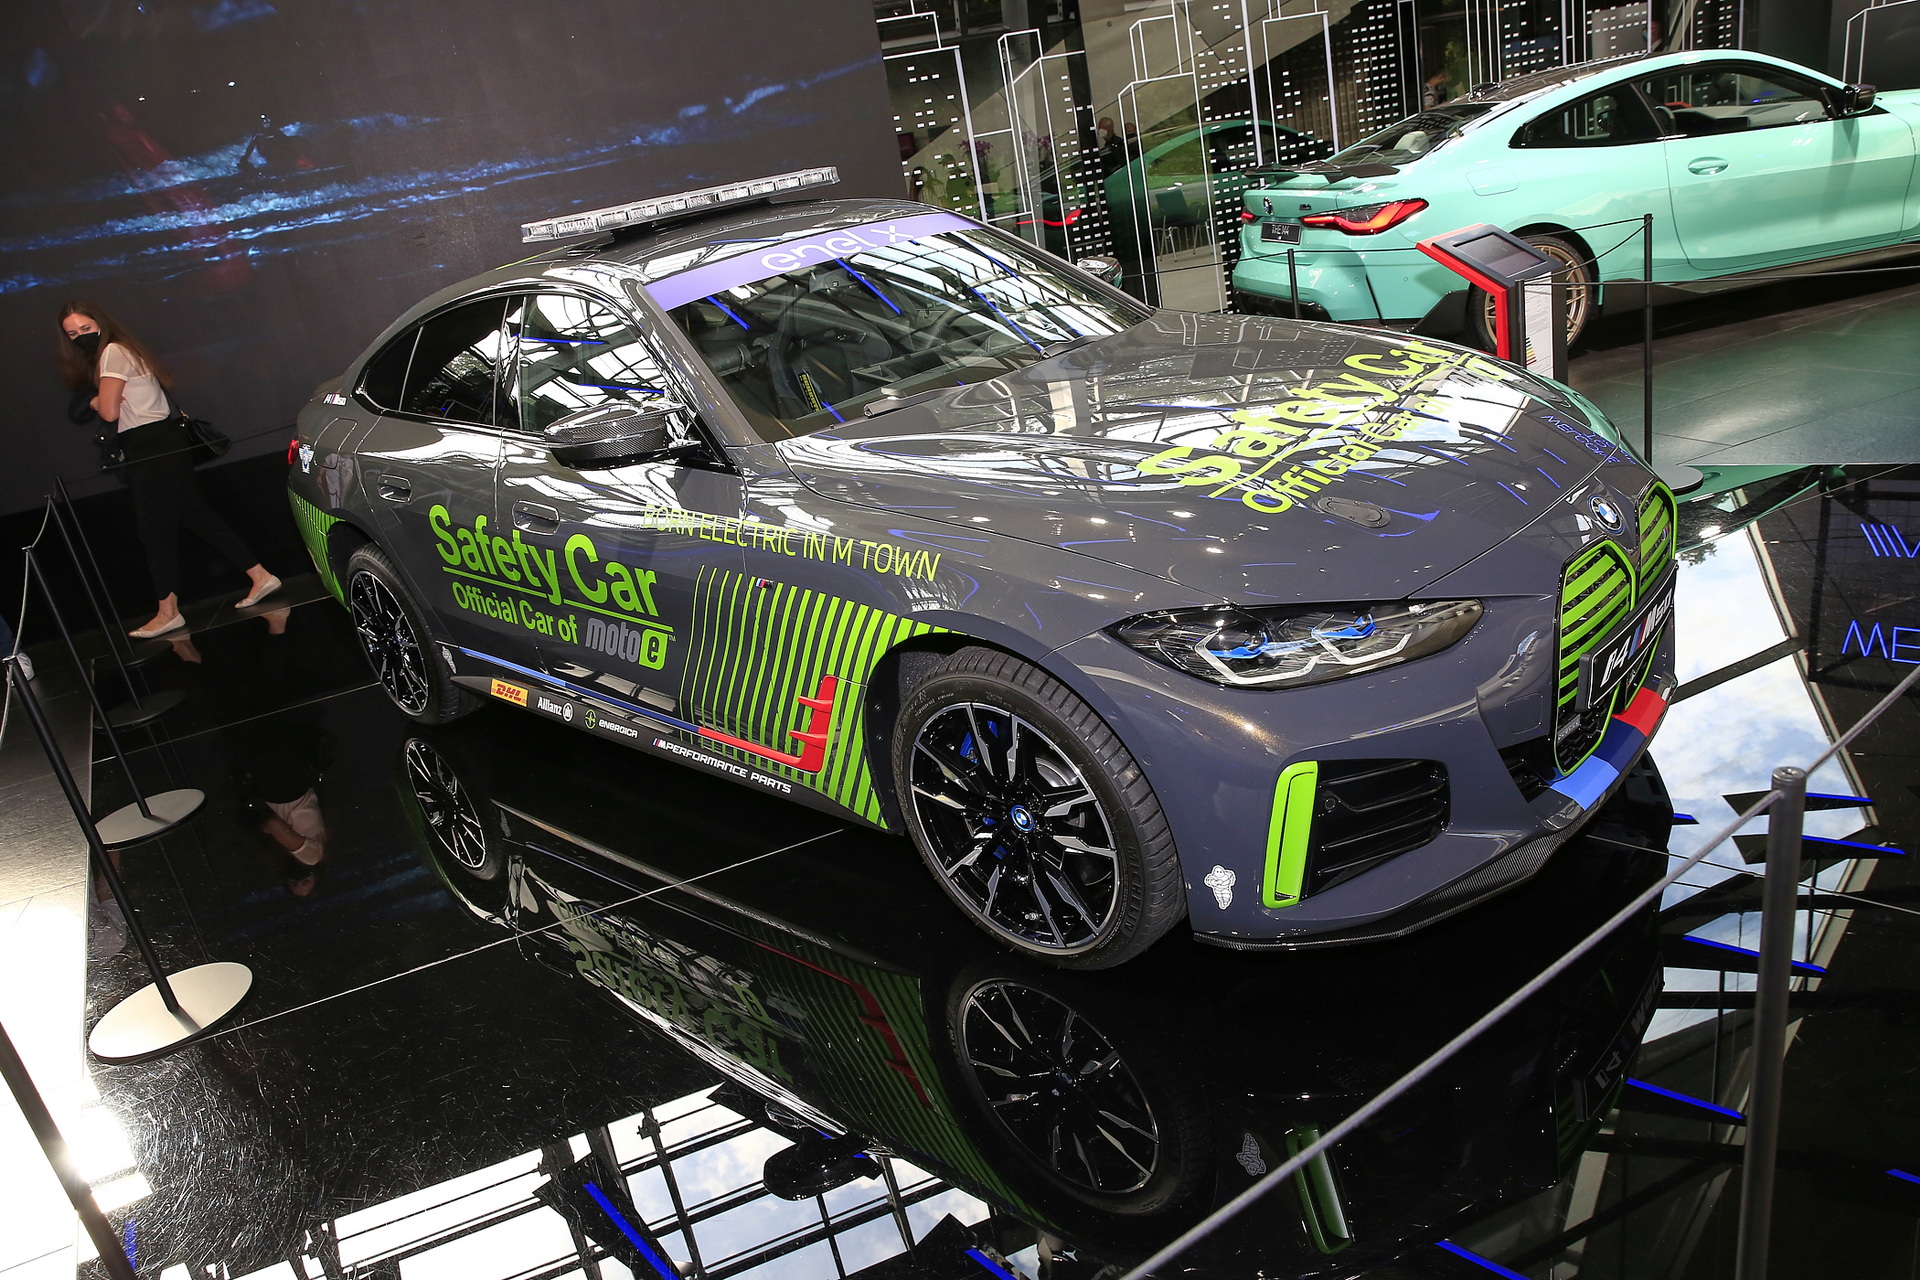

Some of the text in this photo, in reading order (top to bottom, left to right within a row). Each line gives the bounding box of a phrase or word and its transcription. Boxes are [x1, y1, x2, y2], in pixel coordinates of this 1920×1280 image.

[760, 228, 879, 273] enel
[1136, 340, 1455, 487] Safety Car
[1241, 436, 1383, 514] Official
[1360, 408, 1427, 440] Car
[428, 504, 660, 617] Safety Car
[642, 504, 942, 582] BORN ELECTRIC IN M TOWN
[452, 581, 519, 625] Official
[519, 599, 554, 636] Car
[557, 614, 579, 645] of
[495, 683, 524, 702] DHL
[537, 696, 564, 716] Allianz
[750, 771, 792, 794] PARTS
